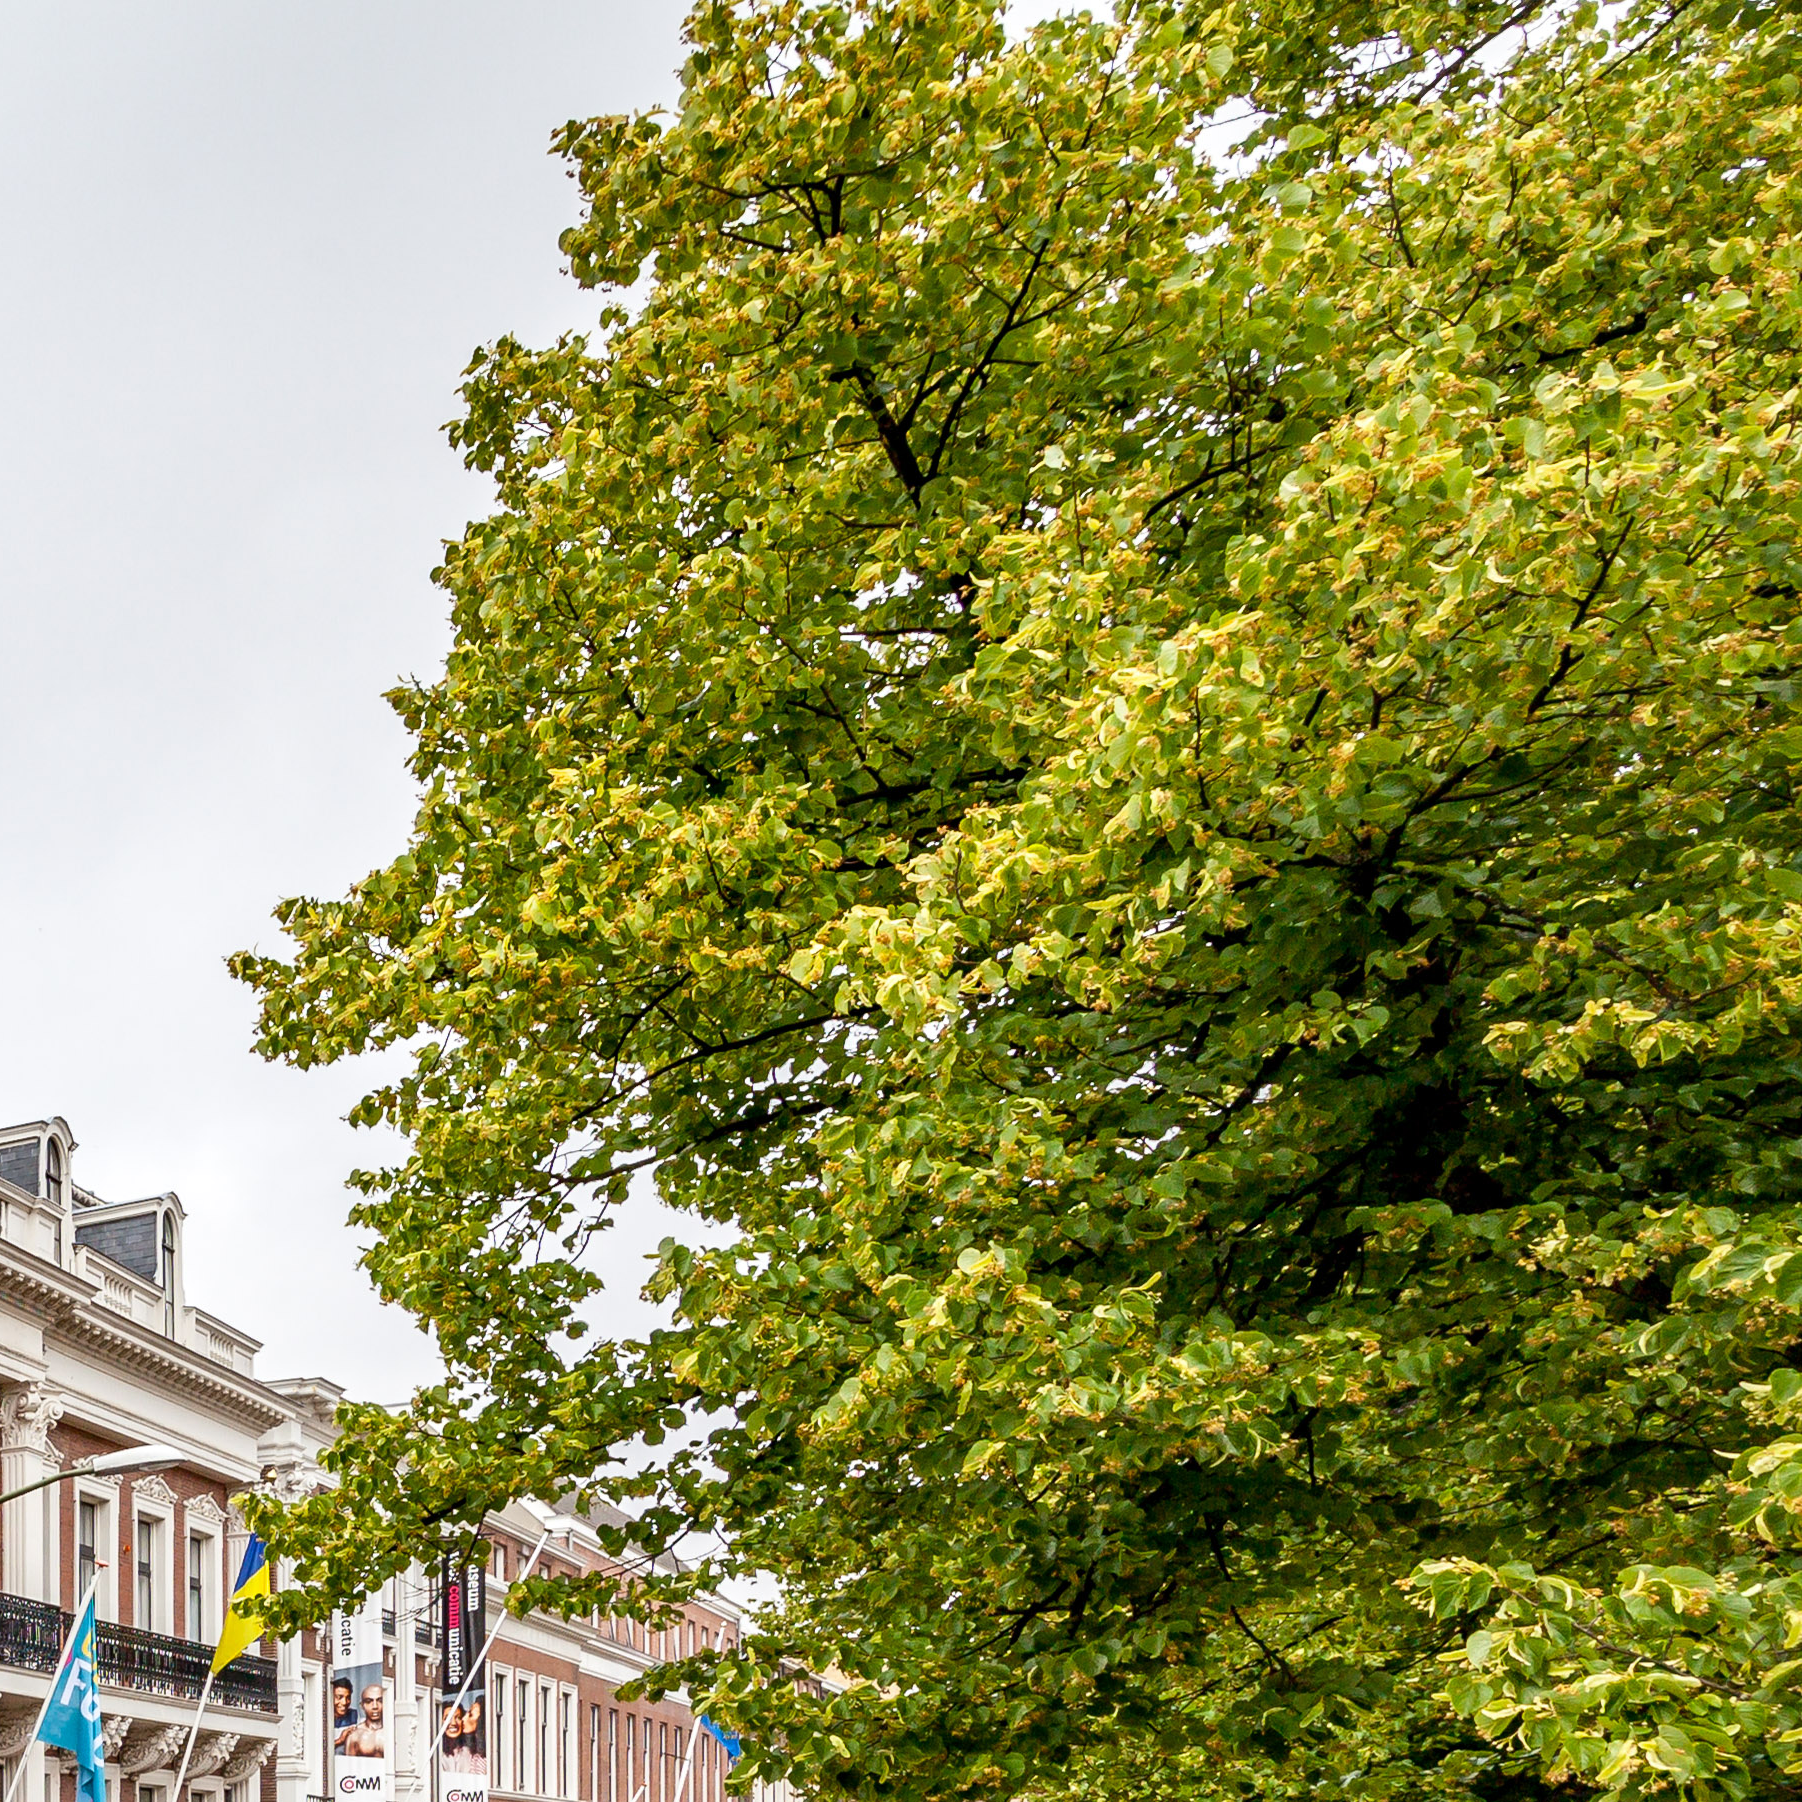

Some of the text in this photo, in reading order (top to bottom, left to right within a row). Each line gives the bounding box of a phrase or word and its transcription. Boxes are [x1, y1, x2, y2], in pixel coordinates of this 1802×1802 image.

[467, 1557, 479, 1612] useum
[341, 1598, 355, 1656] icatie
[448, 1585, 463, 1685] communicatie
